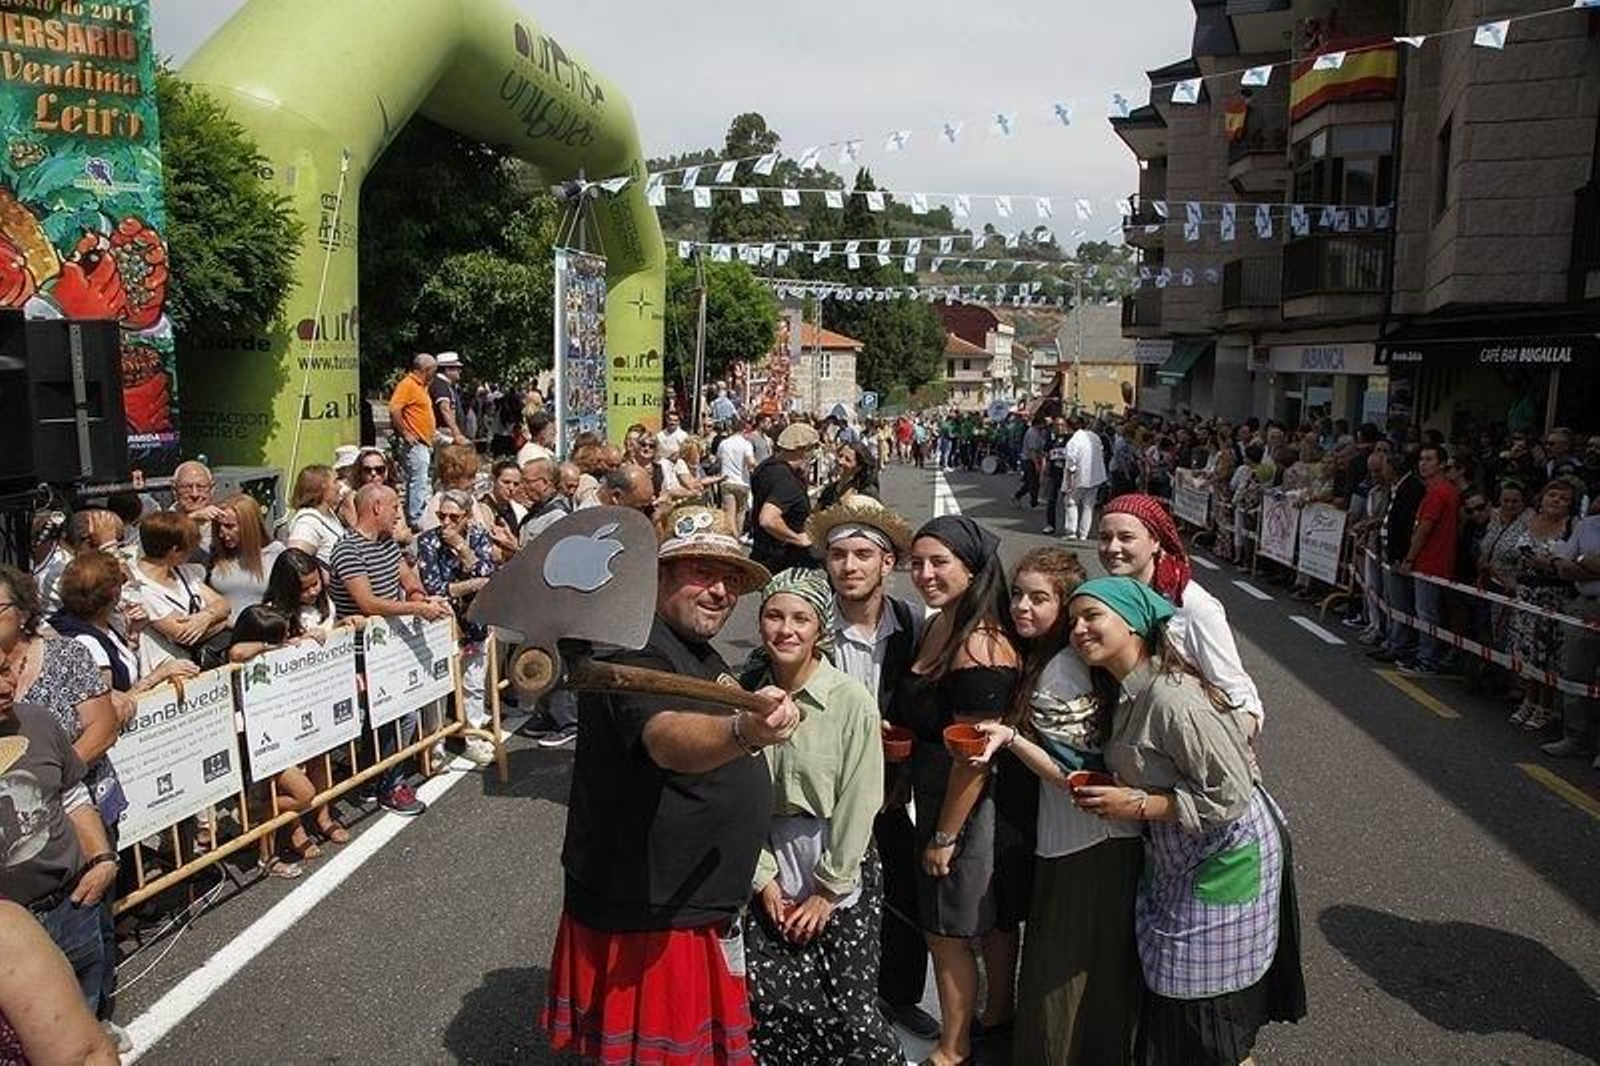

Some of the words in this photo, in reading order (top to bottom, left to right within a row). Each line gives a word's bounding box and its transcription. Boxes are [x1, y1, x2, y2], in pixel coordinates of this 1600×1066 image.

[90, 4, 135, 23] 2014
[2, 51, 138, 95] Vendima
[35, 93, 143, 136] Leiro
[1301, 347, 1344, 369] ABANCA
[1519, 346, 1571, 362] BUGALLAL
[301, 394, 339, 421] La
[613, 393, 636, 406] La
